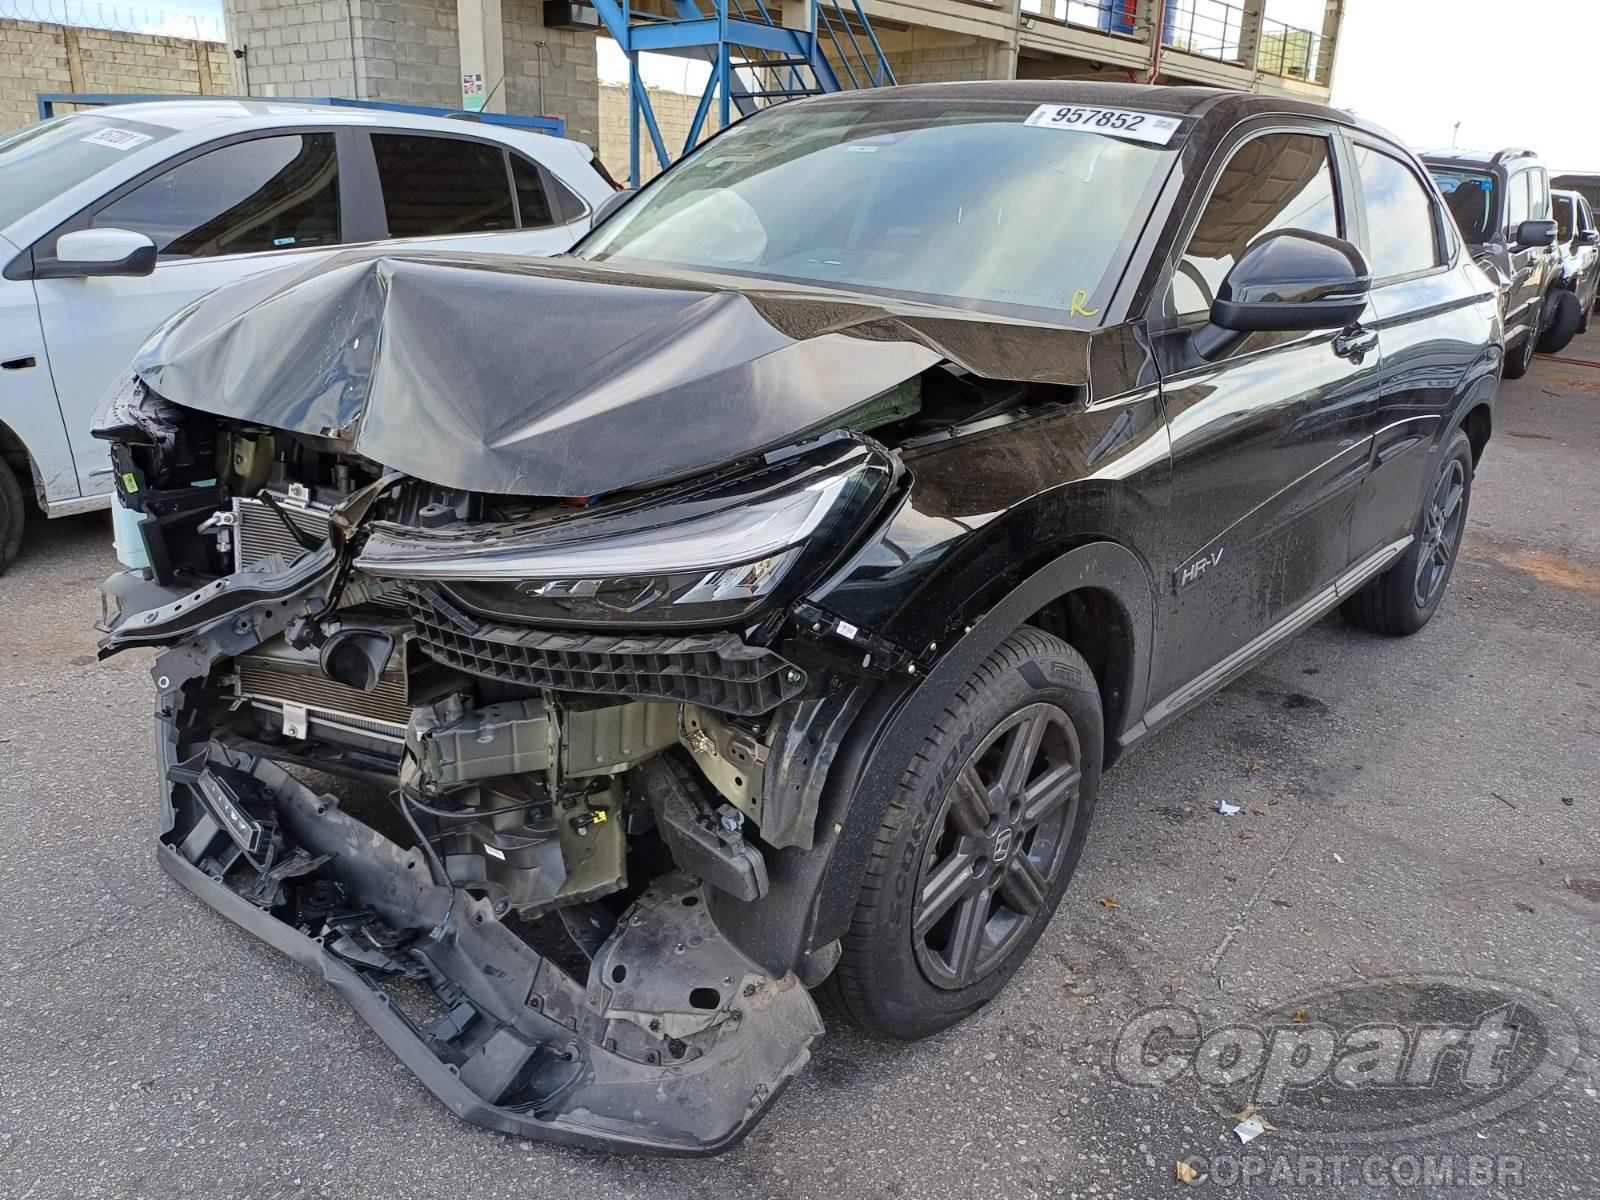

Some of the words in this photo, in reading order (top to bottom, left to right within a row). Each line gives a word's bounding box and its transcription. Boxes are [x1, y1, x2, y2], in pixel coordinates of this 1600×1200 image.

[1051, 107, 1145, 132] 957852
[1070, 288, 1099, 319] R
[1181, 547, 1224, 586] HR-V
